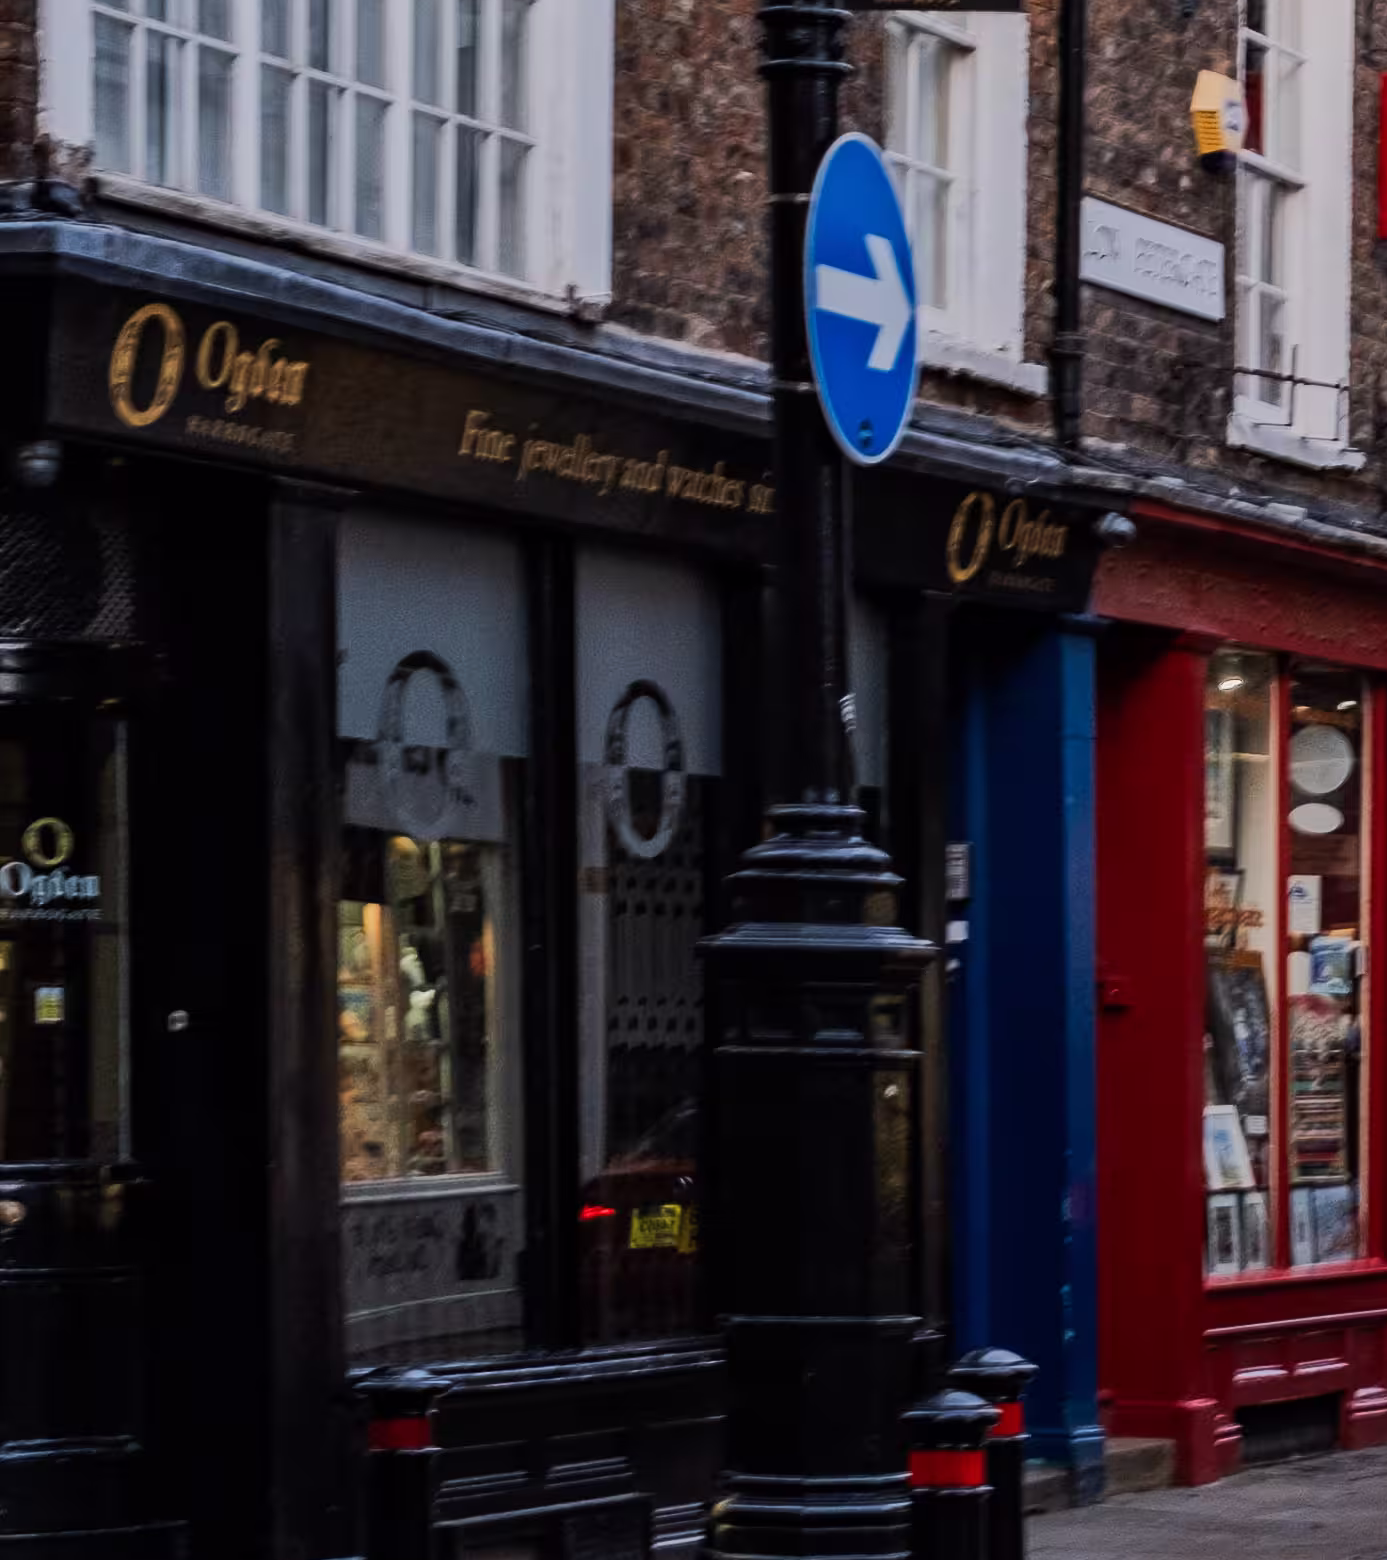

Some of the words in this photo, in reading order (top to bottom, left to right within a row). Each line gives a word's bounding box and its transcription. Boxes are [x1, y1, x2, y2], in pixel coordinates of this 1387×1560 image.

[196, 321, 309, 413] Ogden
[458, 410, 516, 461] Fine
[515, 421, 625, 498] jewellery
[619, 448, 666, 491] and
[666, 461, 744, 509] watches
